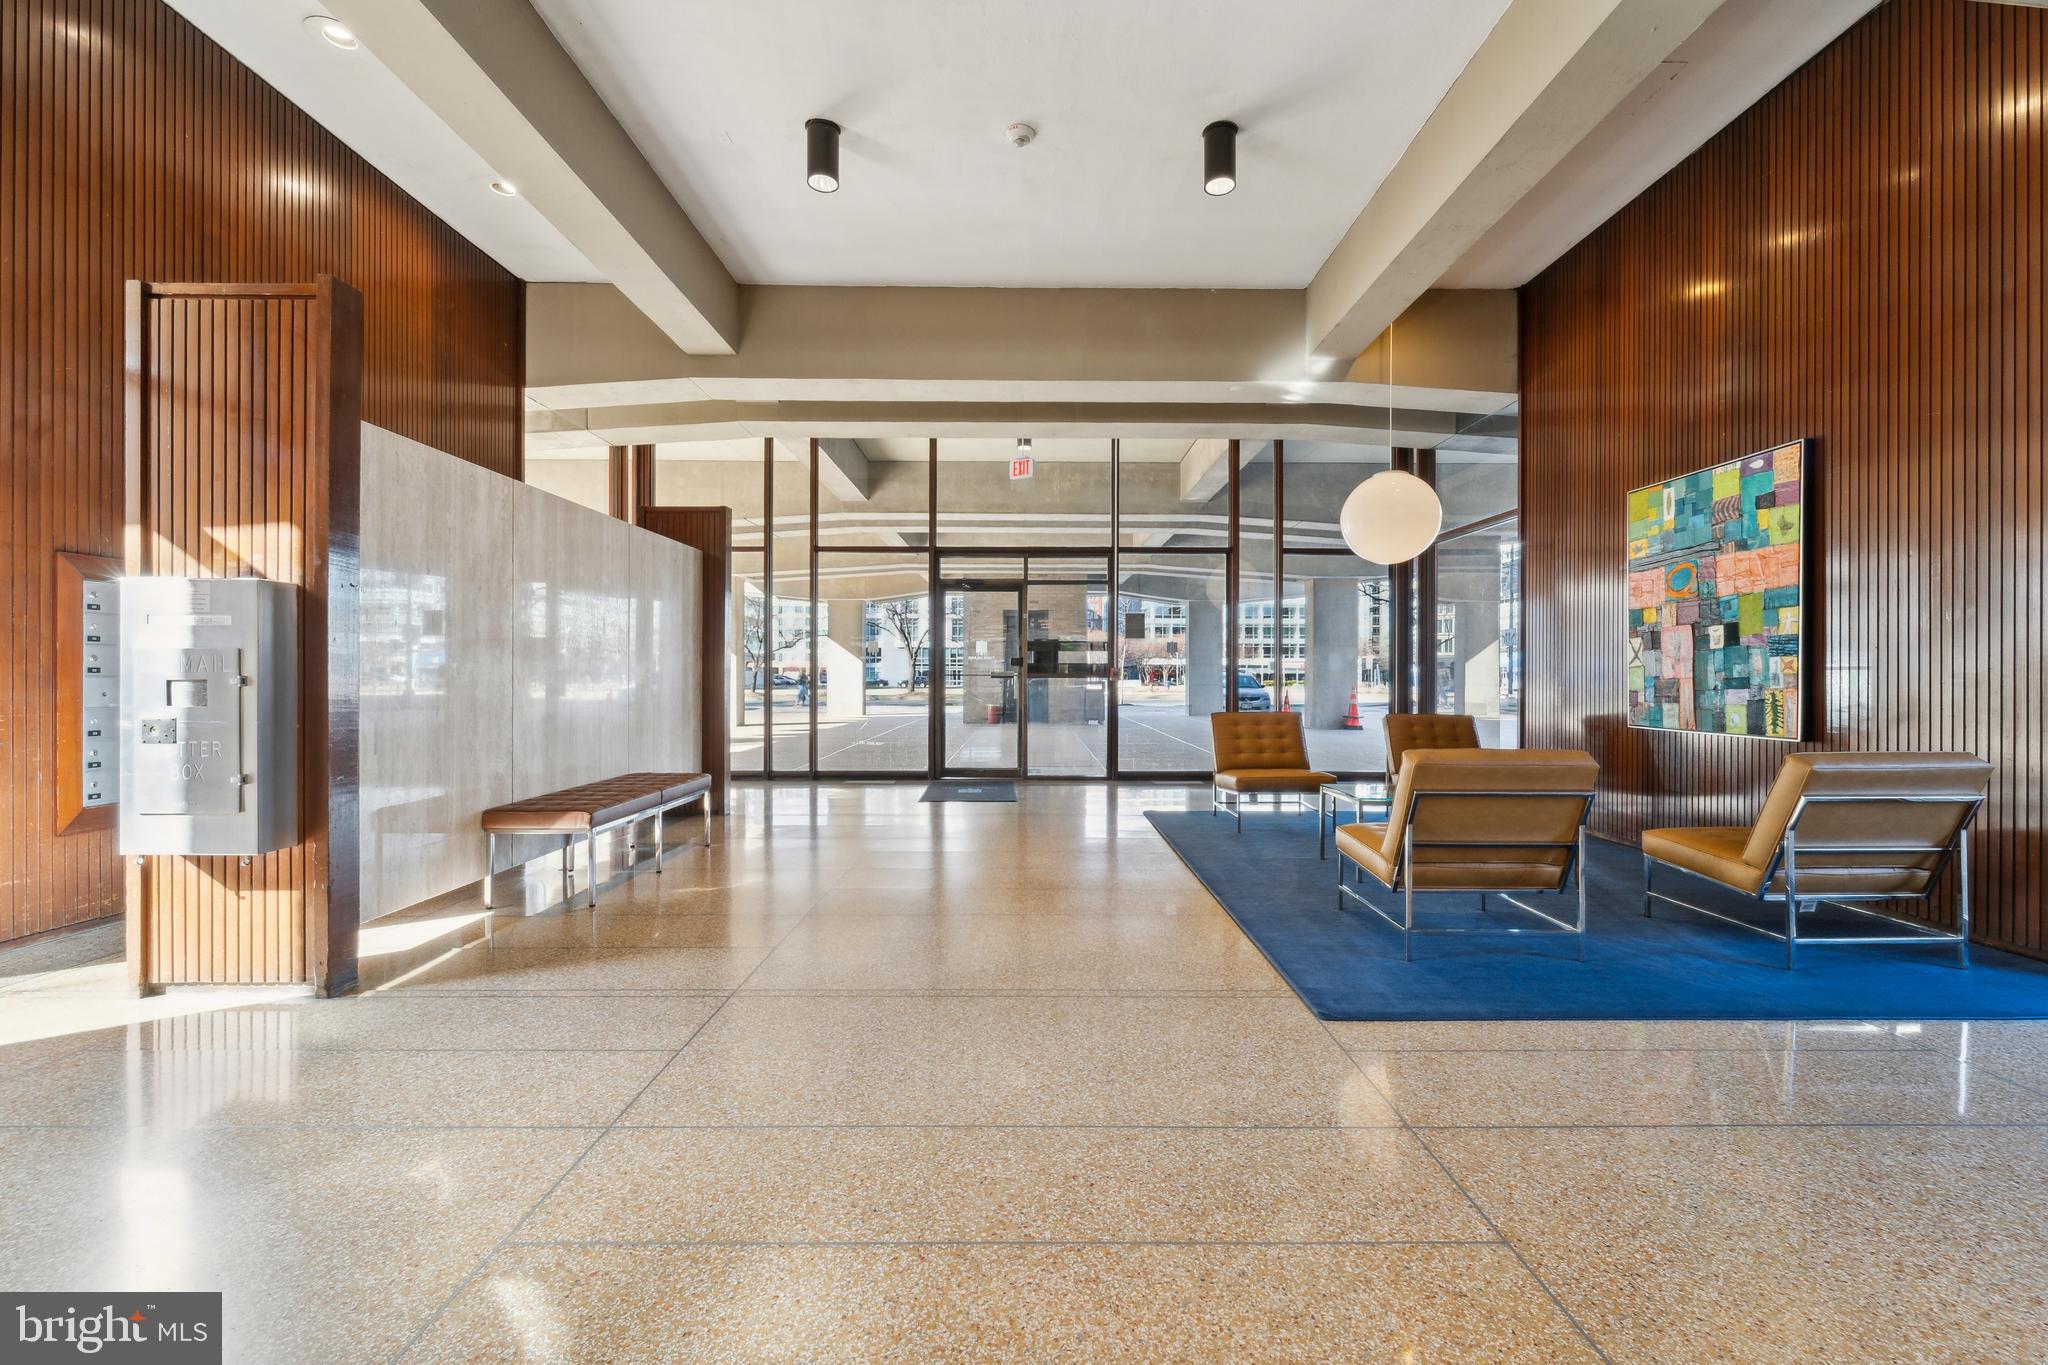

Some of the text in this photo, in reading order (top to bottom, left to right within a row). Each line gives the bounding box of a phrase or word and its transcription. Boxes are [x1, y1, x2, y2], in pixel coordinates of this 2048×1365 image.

[1013, 460, 1030, 477] EXIT
[180, 655, 230, 673] MAIL
[177, 741, 223, 759] TTER
